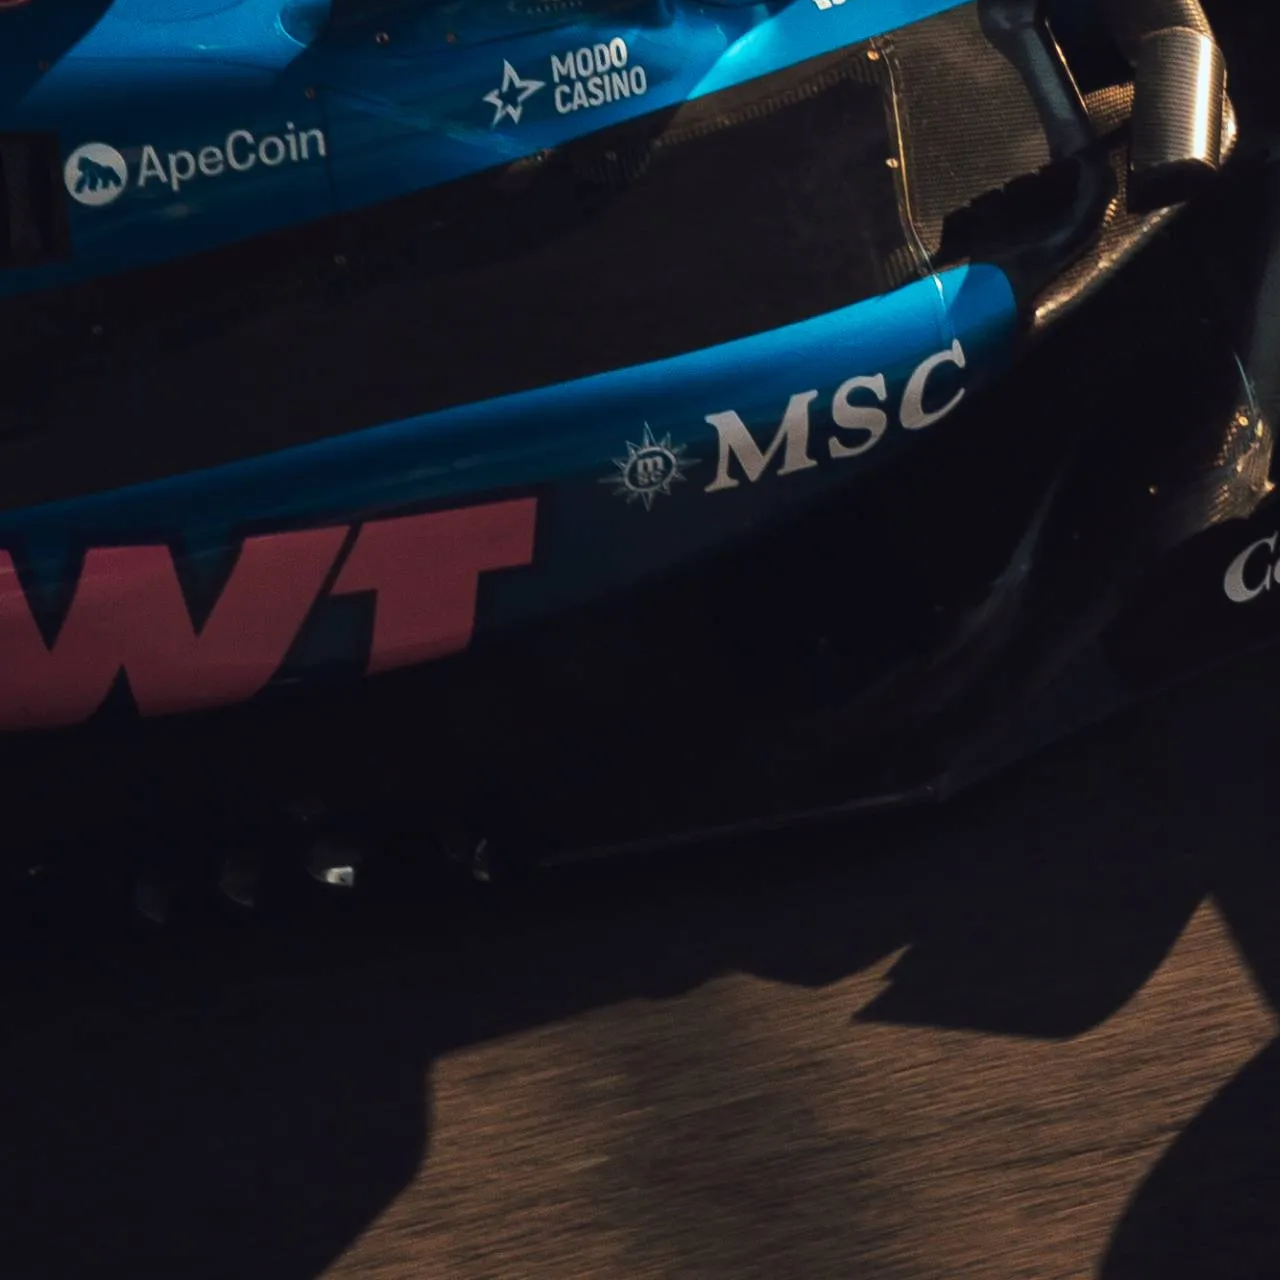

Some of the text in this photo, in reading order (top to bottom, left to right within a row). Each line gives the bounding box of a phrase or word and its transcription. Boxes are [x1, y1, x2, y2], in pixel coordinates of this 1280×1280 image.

[550, 36, 629, 83] MODO
[554, 64, 648, 114] CASINO
[135, 121, 328, 193] ApeCoin
[704, 338, 968, 493] MSC
